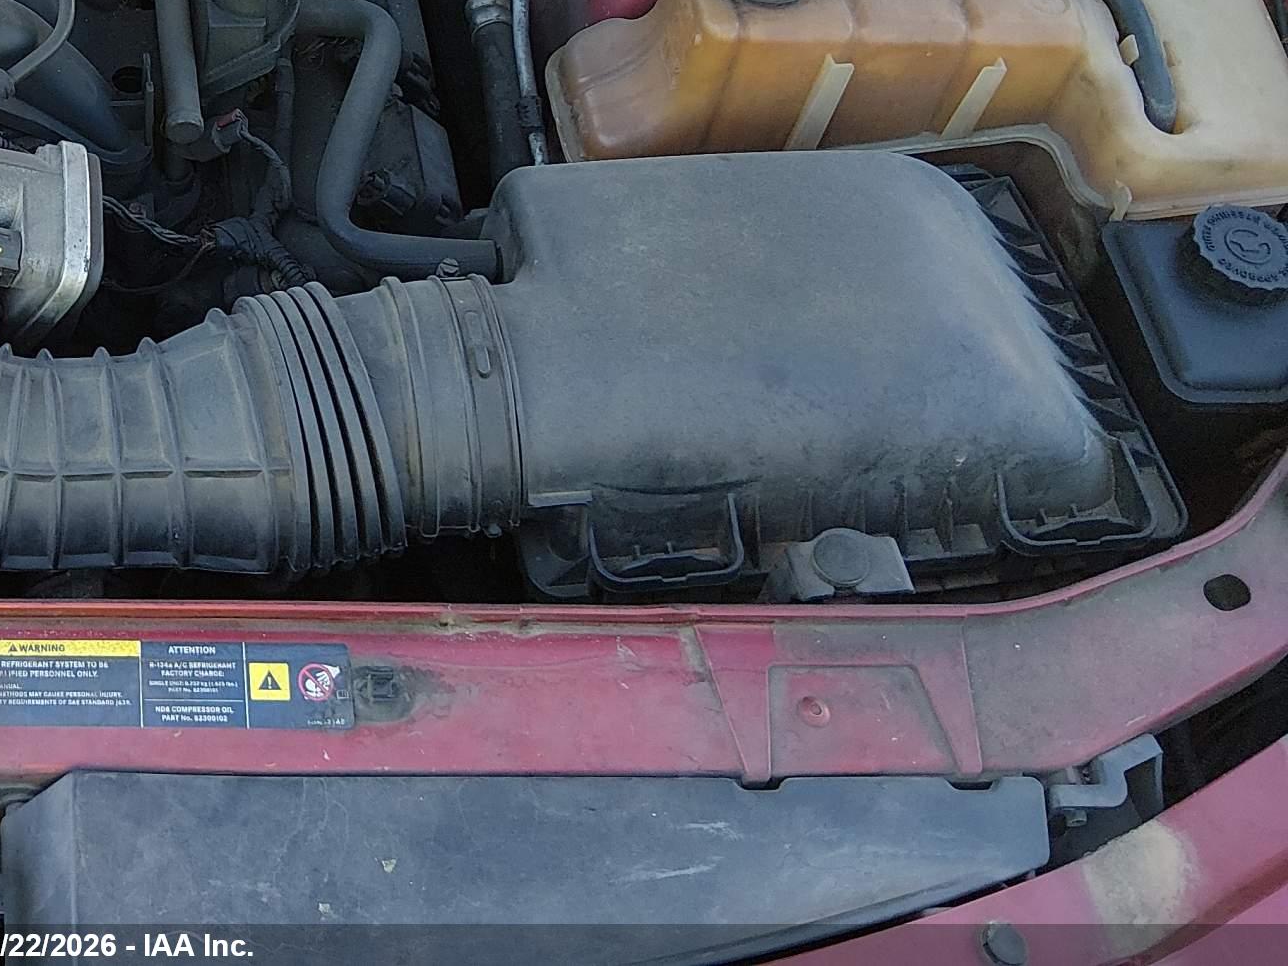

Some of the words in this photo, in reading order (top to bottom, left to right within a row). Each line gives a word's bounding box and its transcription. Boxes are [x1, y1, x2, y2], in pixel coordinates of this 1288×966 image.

[18, 643, 66, 653] WARNING
[168, 645, 216, 655] ATTENTION
[1, 660, 53, 669] REFRIGERANT
[55, 660, 85, 669] SYSTEM
[87, 660, 97, 669] TO
[99, 660, 109, 669] BE
[174, 661, 188, 669] A/C
[29, 669, 76, 678] PERSONNEL
[161, 670, 193, 678] FACTORY
[171, 705, 220, 714] COMPRESSOR
[221, 705, 234, 714] OIL
[161, 714, 179, 723] PART
[180, 714, 193, 723] No.
